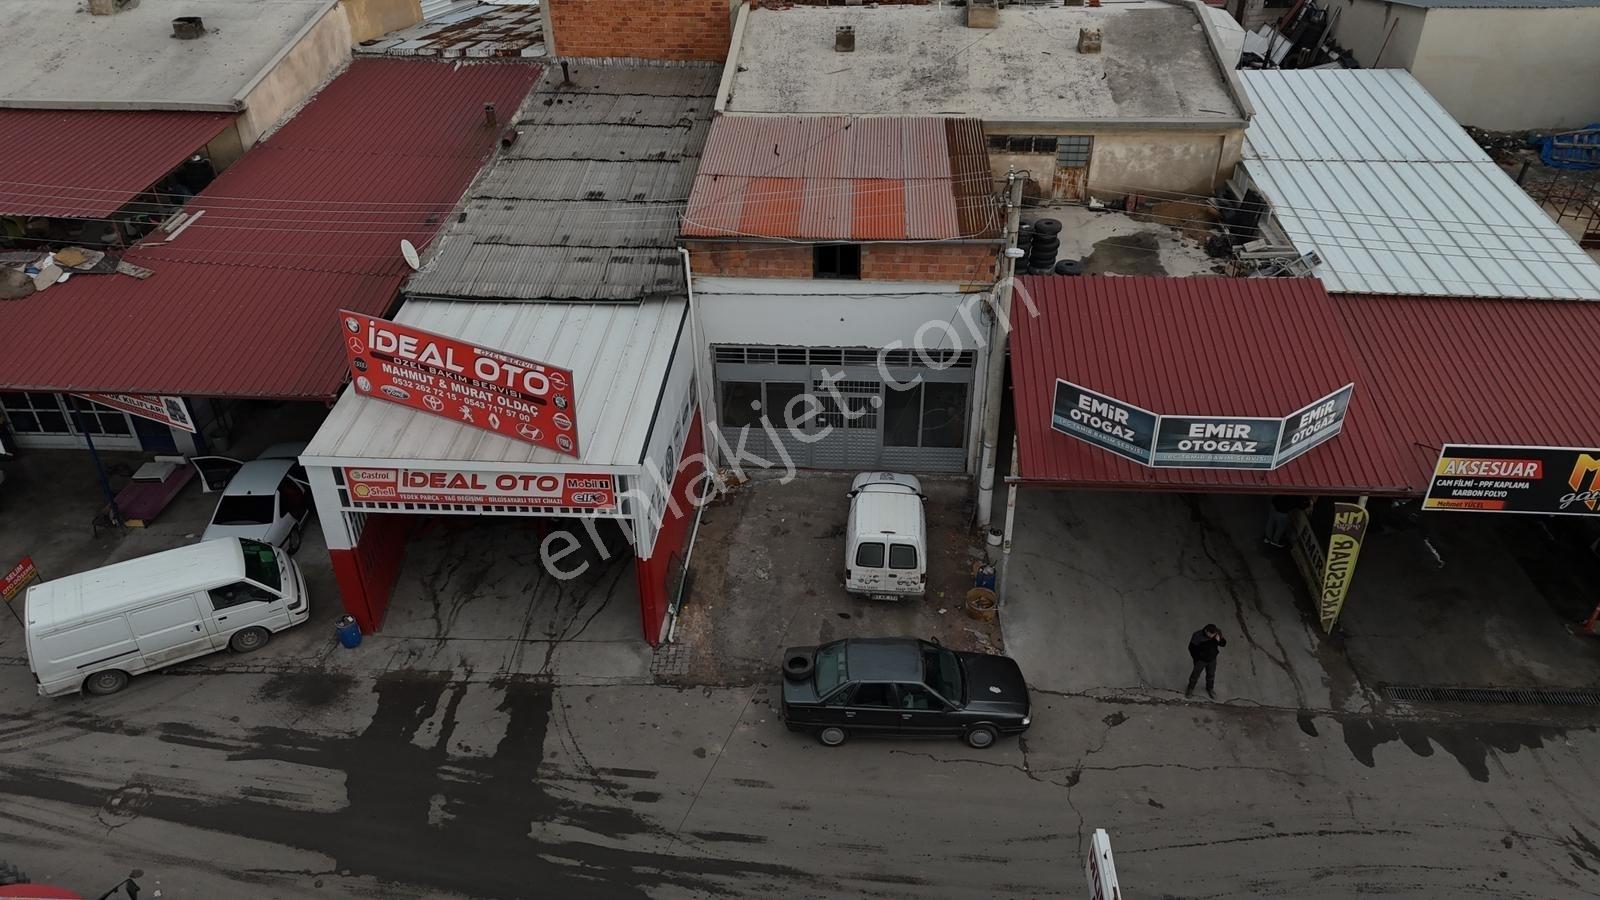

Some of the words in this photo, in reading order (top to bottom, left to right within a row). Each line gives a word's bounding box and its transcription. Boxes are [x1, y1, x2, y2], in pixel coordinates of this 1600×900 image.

[368, 320, 465, 373] İDEAL
[475, 357, 550, 396] OTO
[382, 363, 434, 385] MAHMUT
[439, 379, 447, 389] &
[451, 382, 493, 402] MURAT
[497, 396, 539, 418] OLDAÇ
[392, 377, 413, 388] 0532
[415, 383, 431, 394] 262
[433, 388, 444, 397] 72
[446, 392, 457, 401] 15
[464, 397, 485, 409] 0543
[488, 404, 503, 414] 717
[506, 409, 517, 418] 57
[519, 413, 530, 422] 00
[1070, 408, 1135, 442] OTOGAZ
[1291, 412, 1337, 444] OTOGAZ
[1177, 440, 1258, 453] OTOGAZ
[361, 472, 389, 480] Castrol
[1444, 460, 1538, 477] AKSESUAR
[403, 468, 487, 490] İDEAL
[495, 474, 559, 492] OTO
[568, 479, 598, 488] Mobil
[1436, 479, 1453, 487] CAM
[1454, 479, 1474, 487] FİLMİ
[1478, 480, 1493, 488] PPF
[1494, 481, 1530, 489] KAPLAMA
[370, 487, 395, 497] Shell
[574, 492, 595, 503] elf
[1452, 489, 1483, 497] KARBON
[1483, 490, 1508, 498] FOLYO
